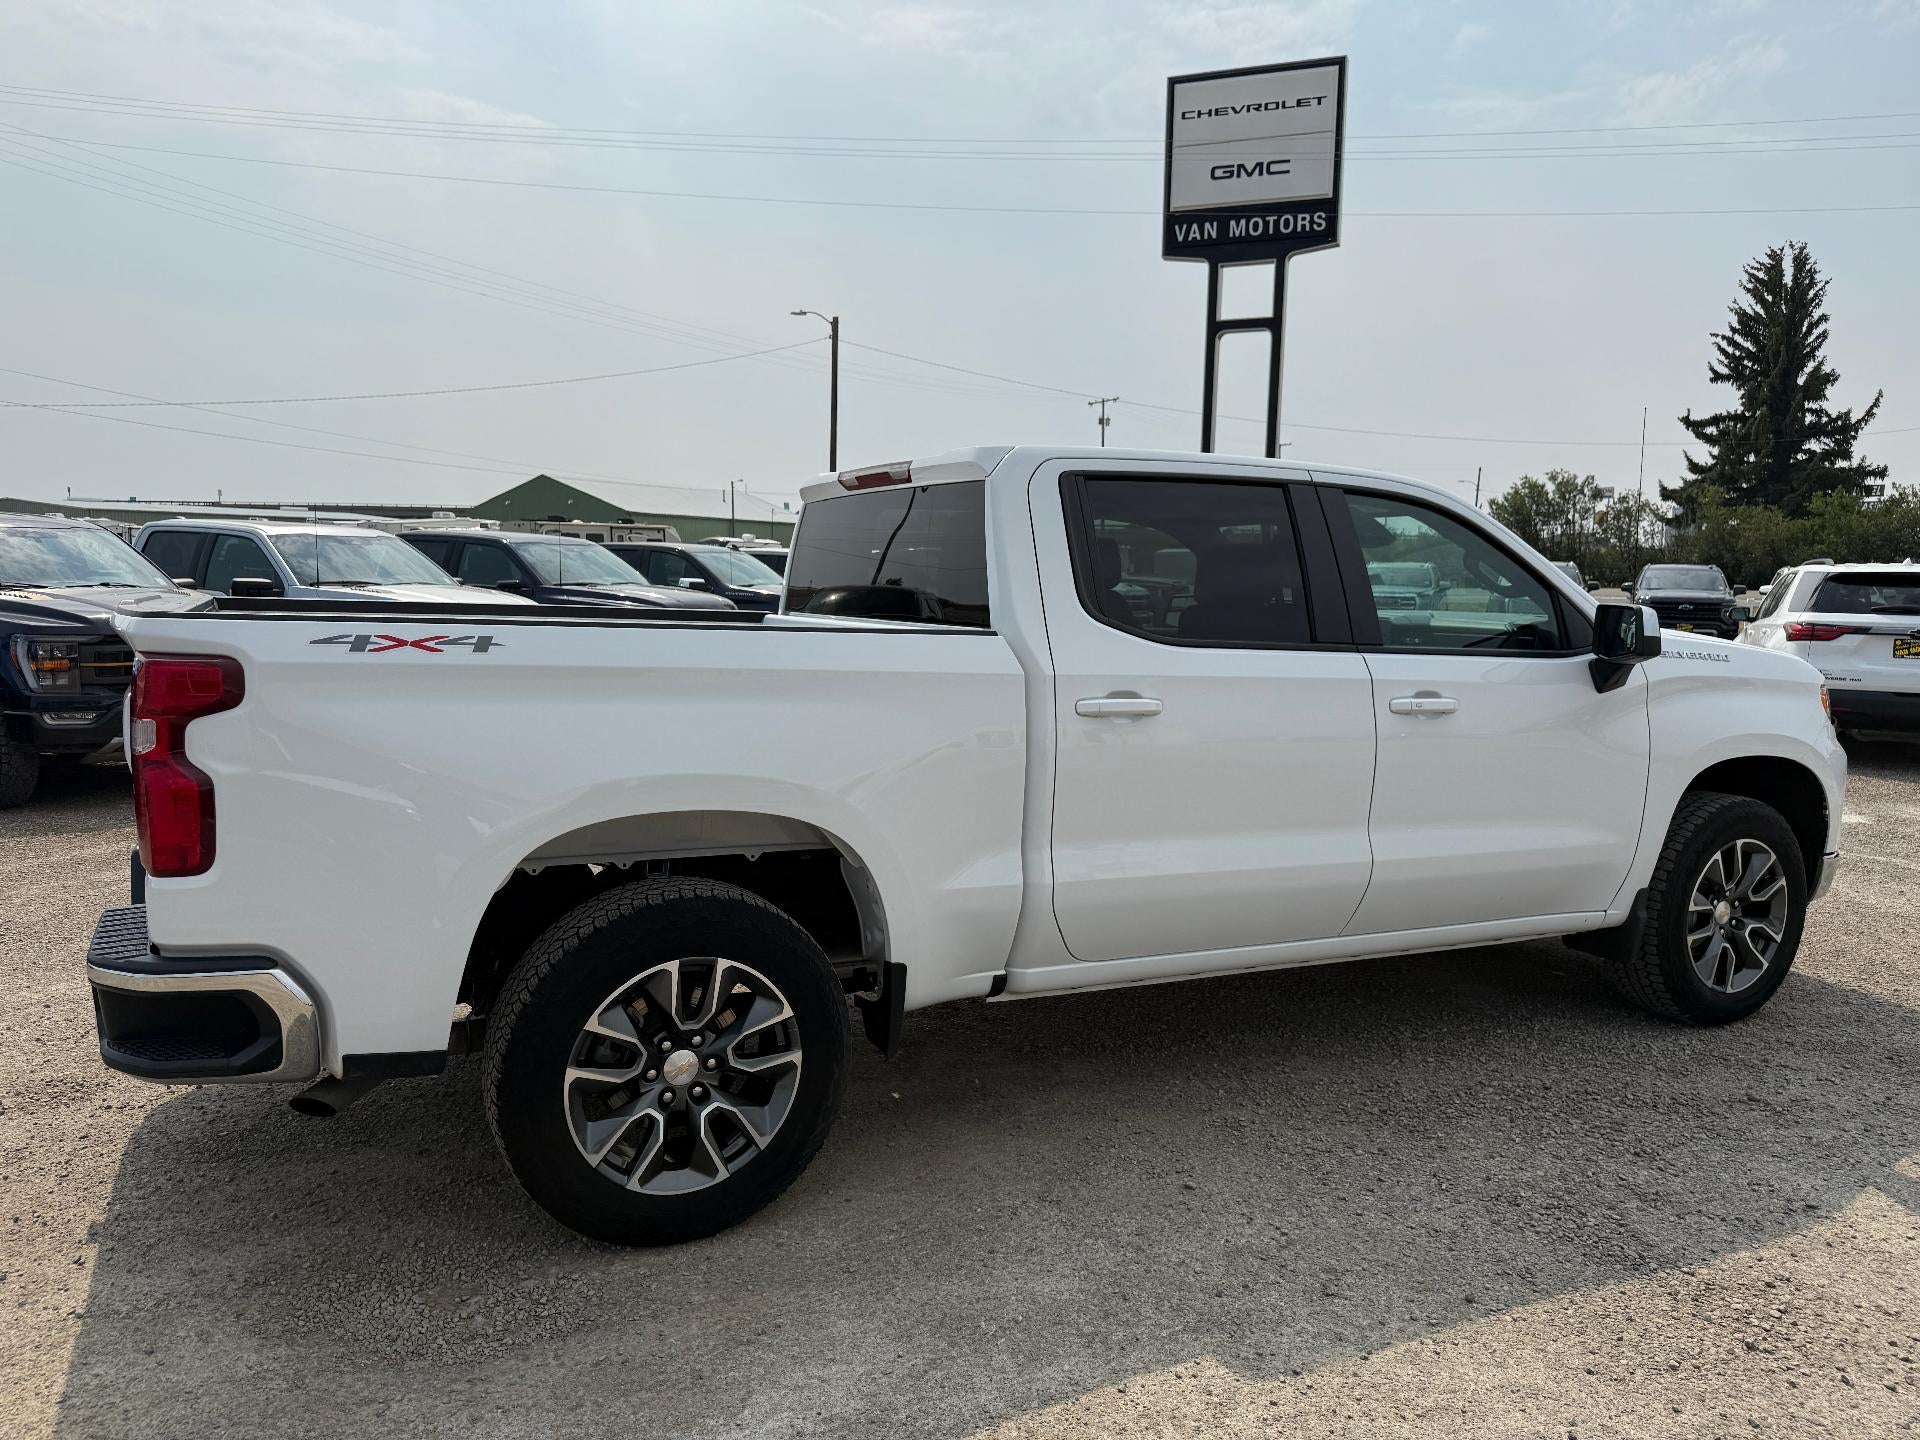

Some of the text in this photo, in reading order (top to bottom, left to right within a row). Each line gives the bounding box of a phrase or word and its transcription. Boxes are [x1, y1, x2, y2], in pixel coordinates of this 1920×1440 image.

[1181, 95, 1328, 120] CHEVROLET
[1210, 159, 1291, 181] GMC
[1174, 212, 1327, 243] VAN MOTORS
